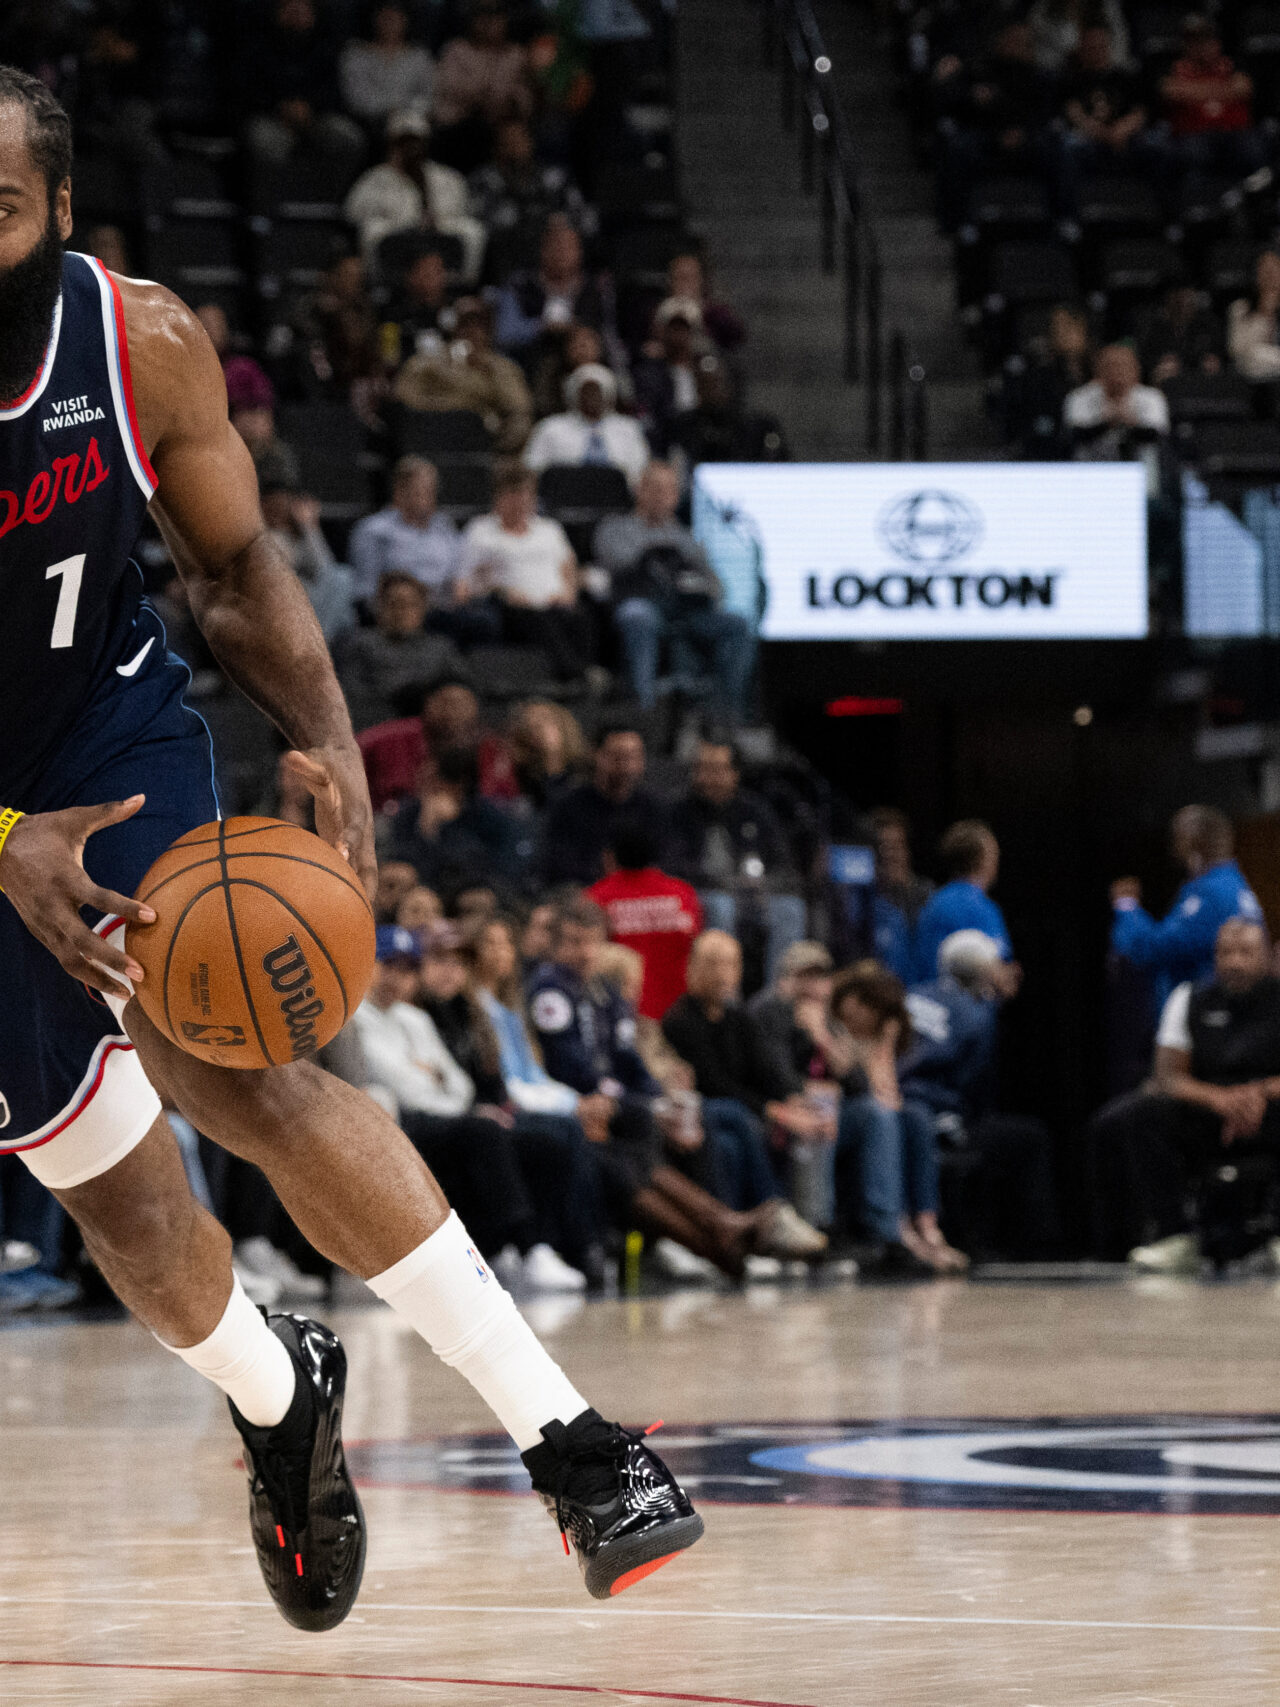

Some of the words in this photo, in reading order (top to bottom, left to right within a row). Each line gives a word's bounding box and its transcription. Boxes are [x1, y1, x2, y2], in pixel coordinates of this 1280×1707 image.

[43, 406, 106, 432] RWANDA
[51, 395, 88, 415] VISIT
[45, 553, 87, 649] 1
[807, 573, 1056, 609] LOCKTON
